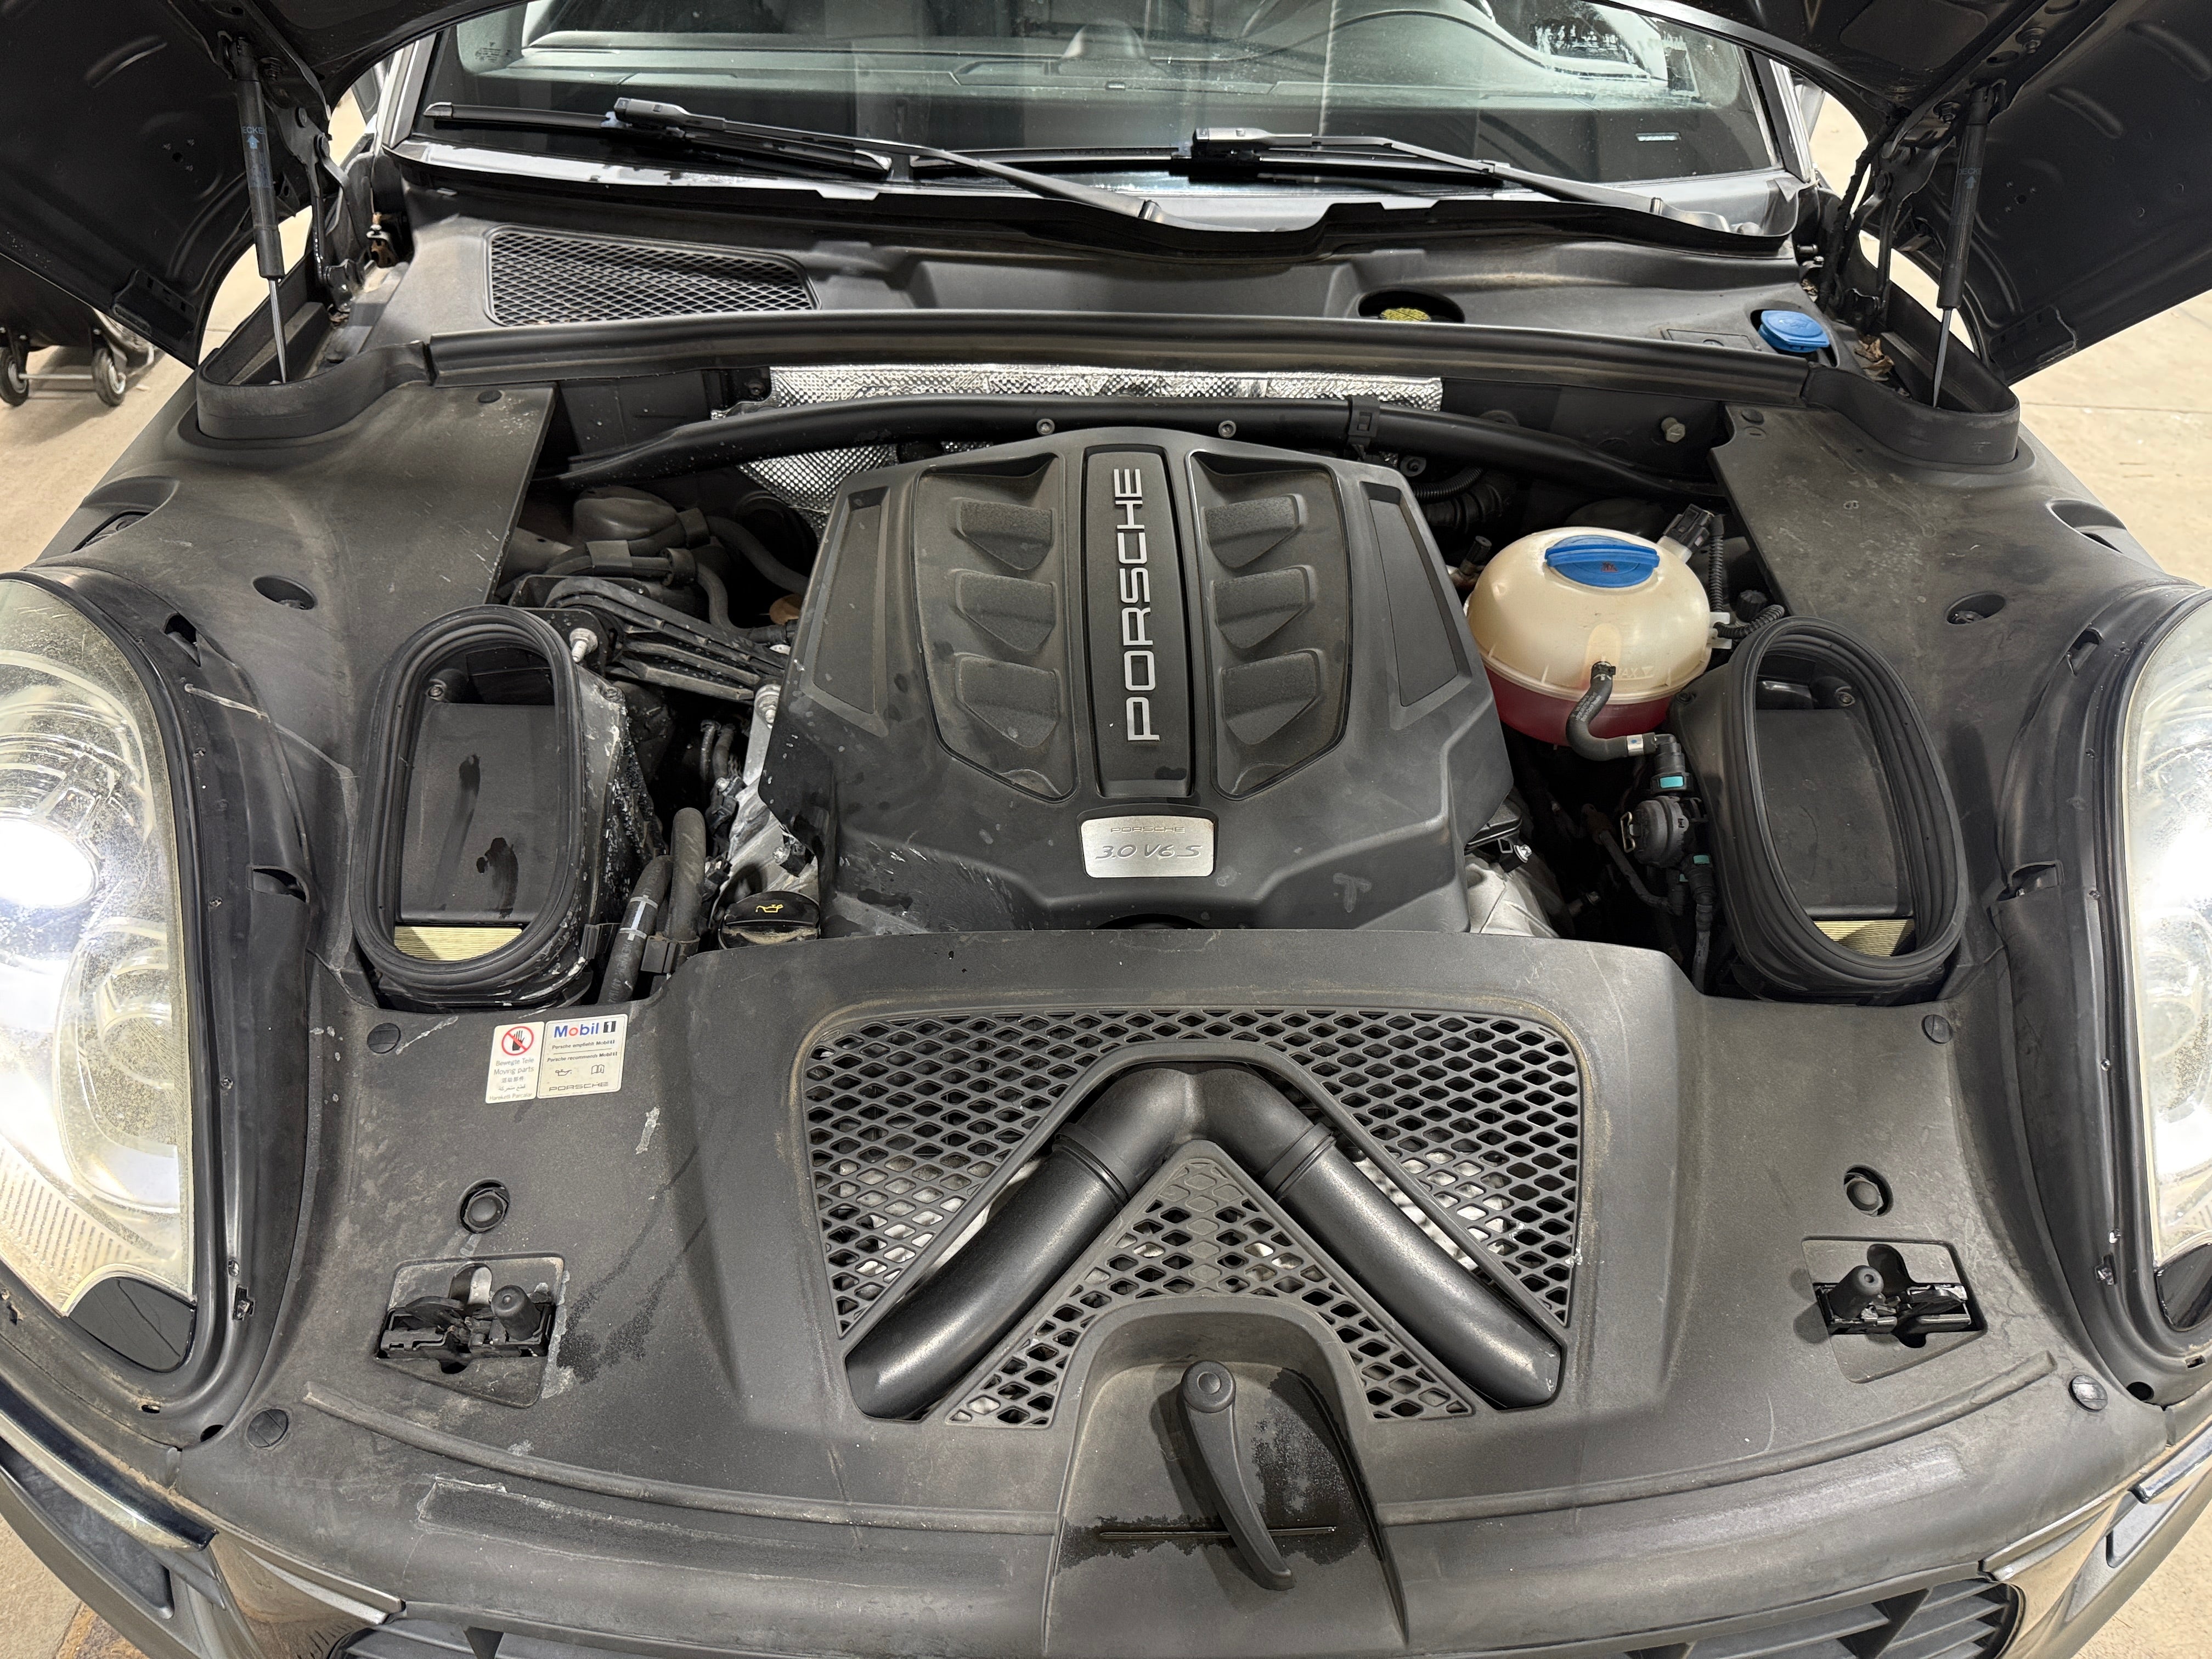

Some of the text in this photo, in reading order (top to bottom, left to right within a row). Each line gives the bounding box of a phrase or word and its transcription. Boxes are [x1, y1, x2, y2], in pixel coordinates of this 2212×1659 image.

[1114, 469, 1160, 741] PORSCHE
[1096, 844, 1137, 860] 3.0
[1144, 844, 1176, 860] V6
[554, 1023, 600, 1038] Mobil
[549, 1082, 609, 1092] PORSCHE
